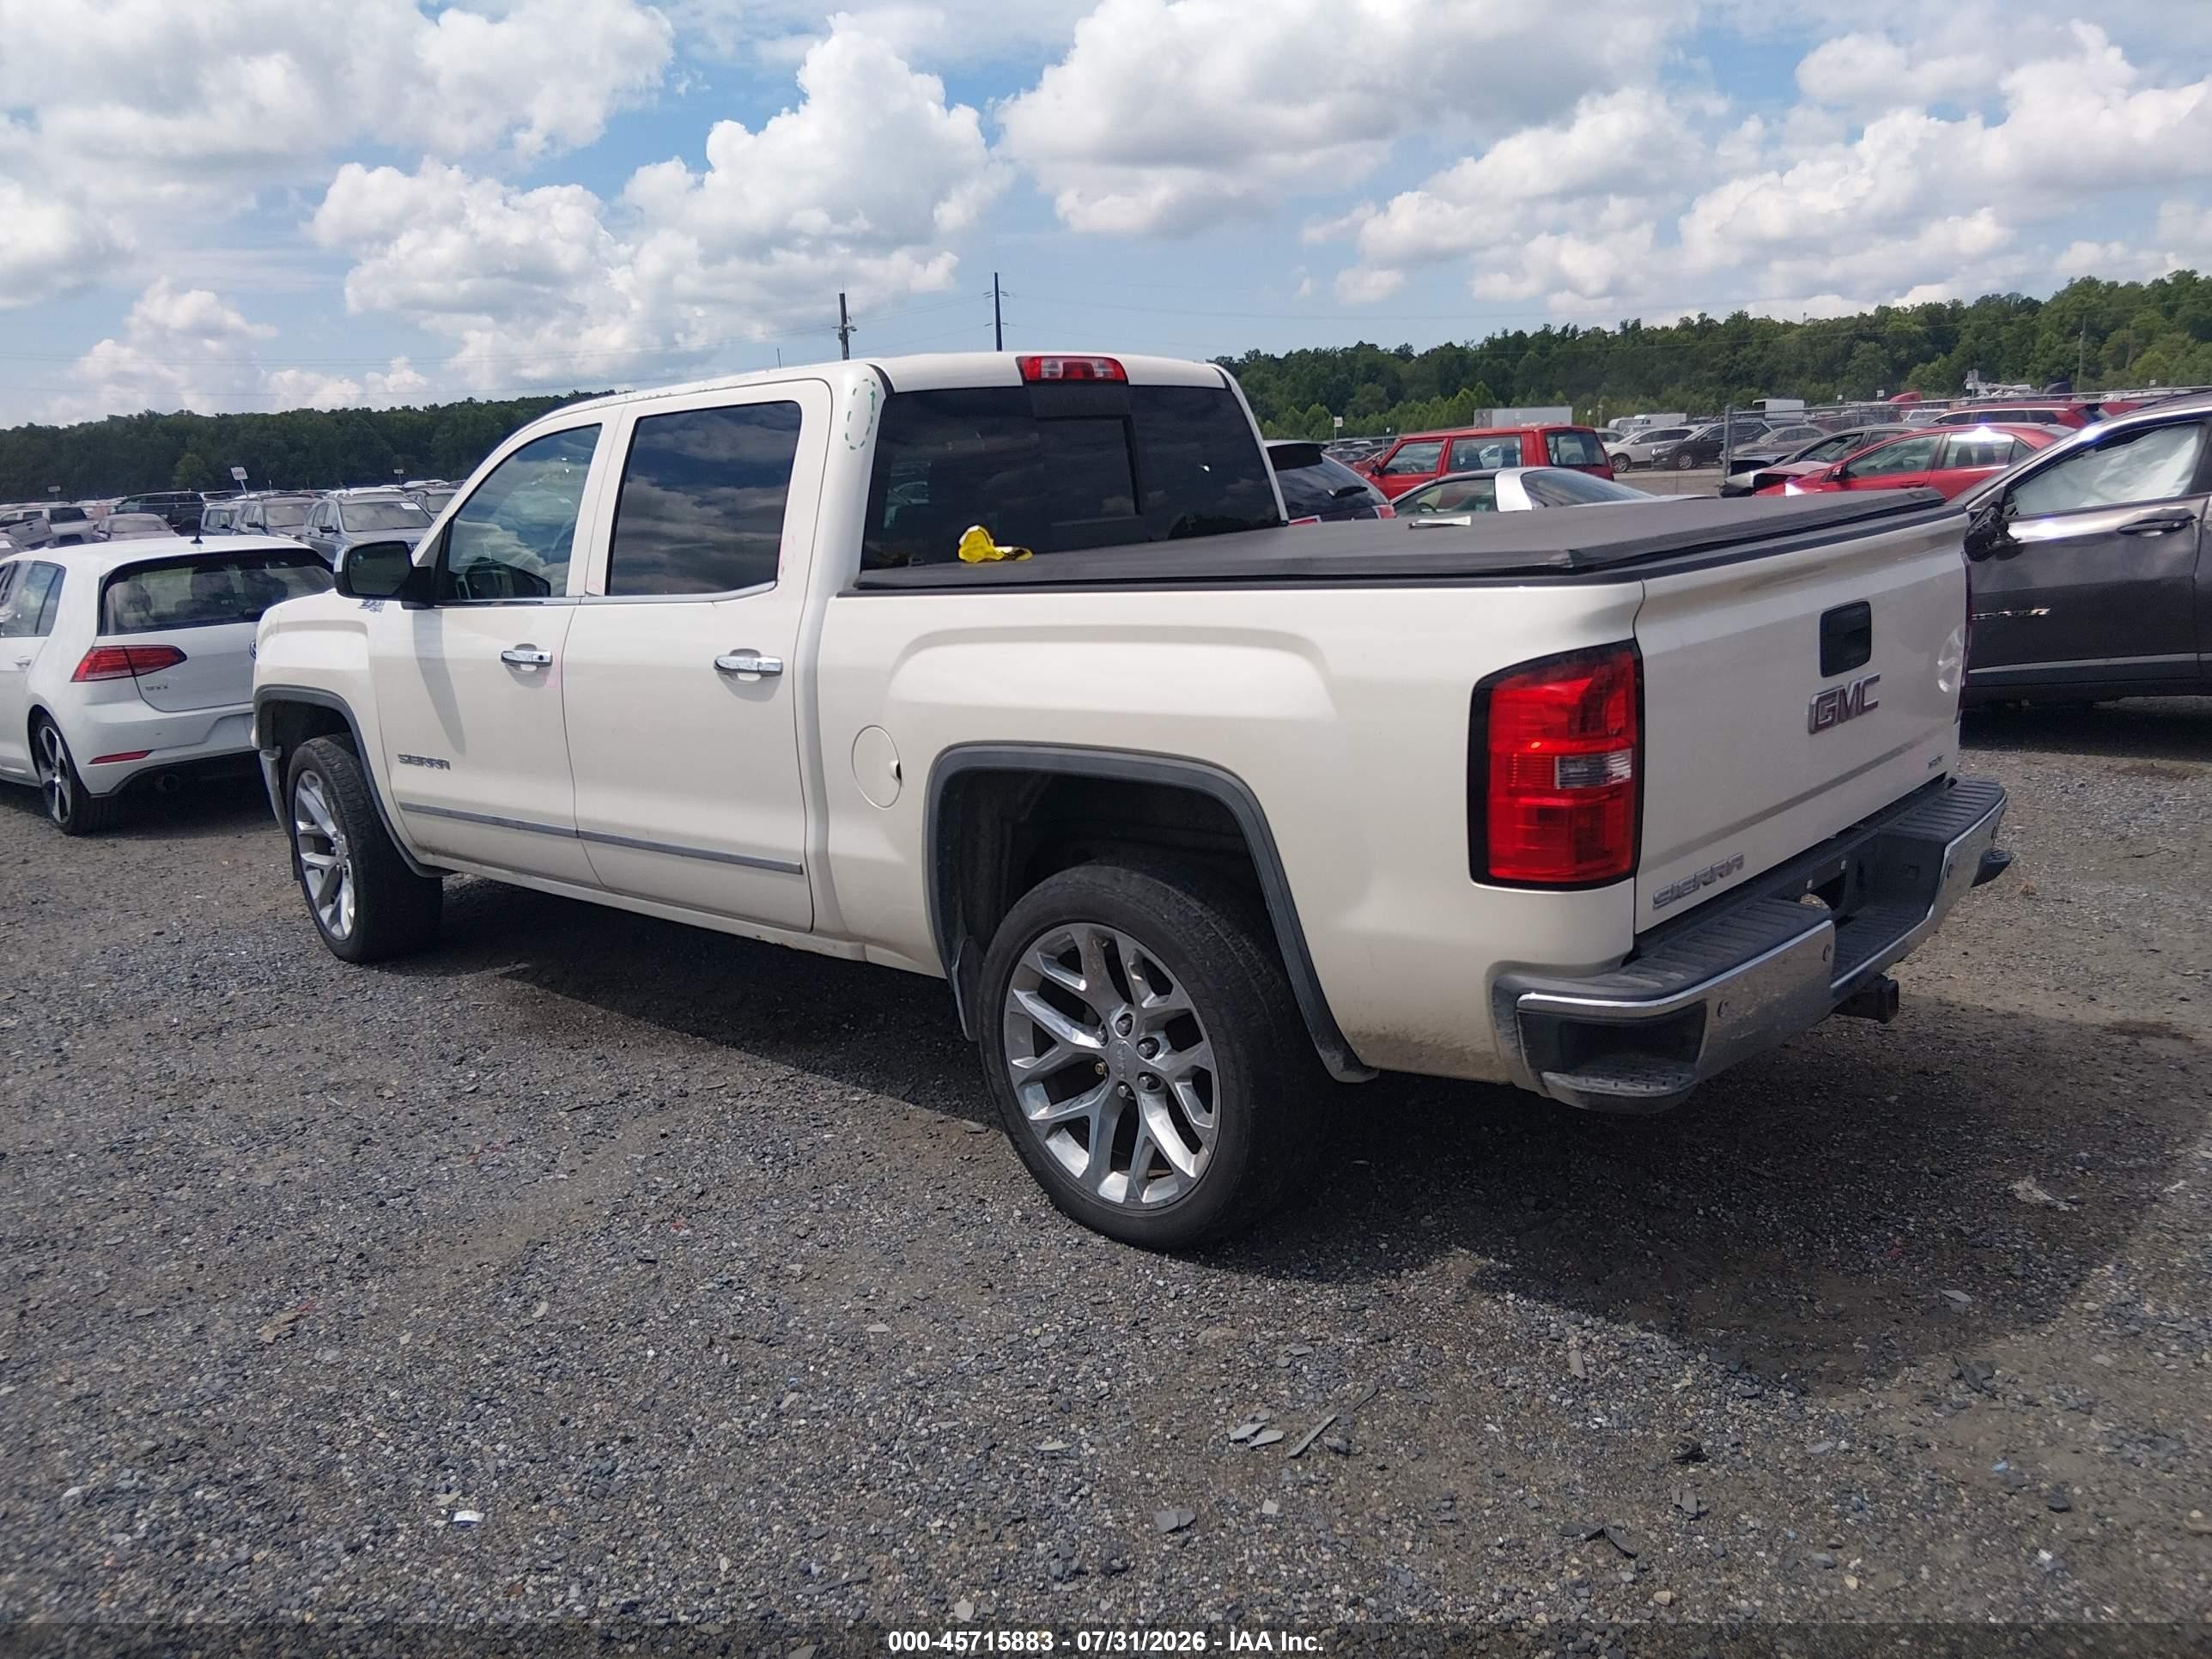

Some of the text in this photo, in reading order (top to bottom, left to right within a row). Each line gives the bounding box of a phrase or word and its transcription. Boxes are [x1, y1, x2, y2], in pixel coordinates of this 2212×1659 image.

[1808, 672, 1881, 735] GMC
[398, 753, 451, 770] SIERRA
[1652, 852, 1745, 910] SIERRA
